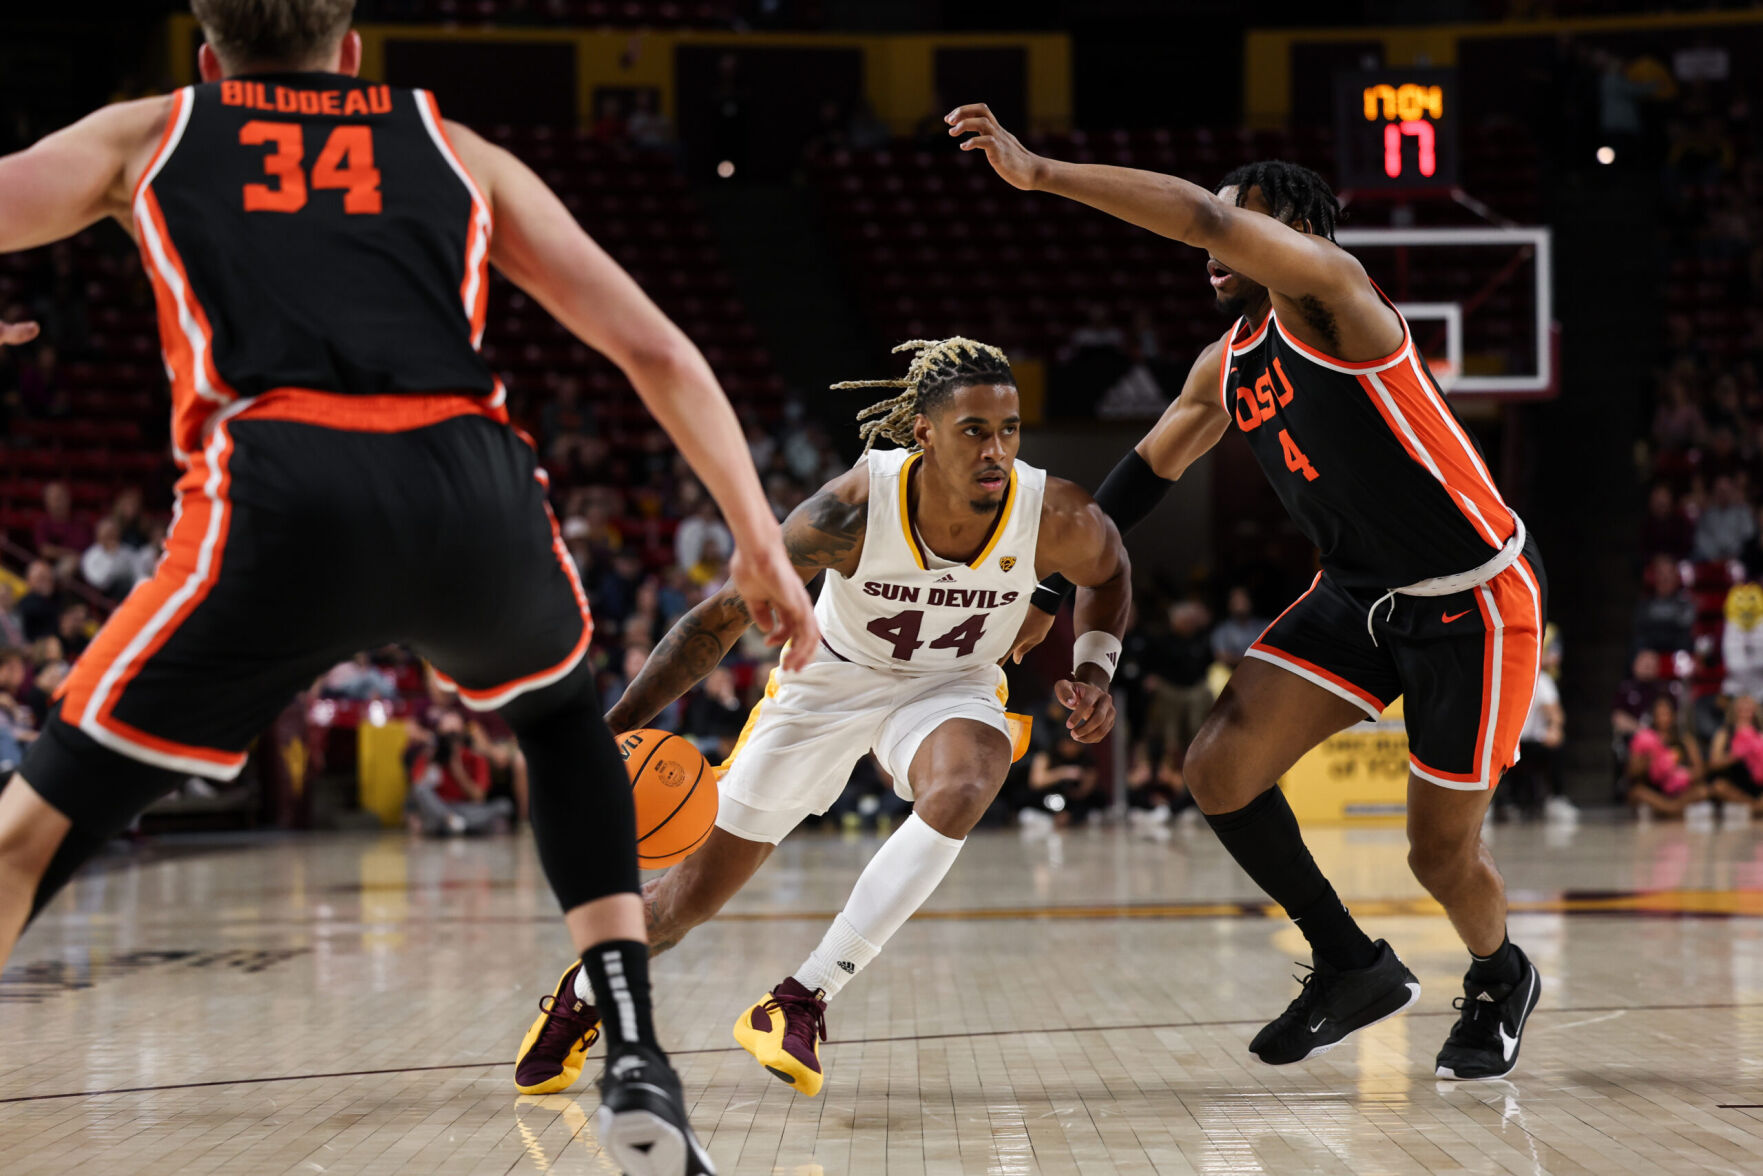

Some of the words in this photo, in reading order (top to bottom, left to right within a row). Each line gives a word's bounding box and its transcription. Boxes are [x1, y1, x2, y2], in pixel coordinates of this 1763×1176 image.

[239, 119, 383, 215] 34
[1384, 119, 1436, 179] 17
[1235, 356, 1294, 432] OSU
[1278, 428, 1321, 482] 4
[862, 581, 921, 603] SUN
[927, 588, 1019, 609] DEVILS
[866, 609, 991, 661] 44
